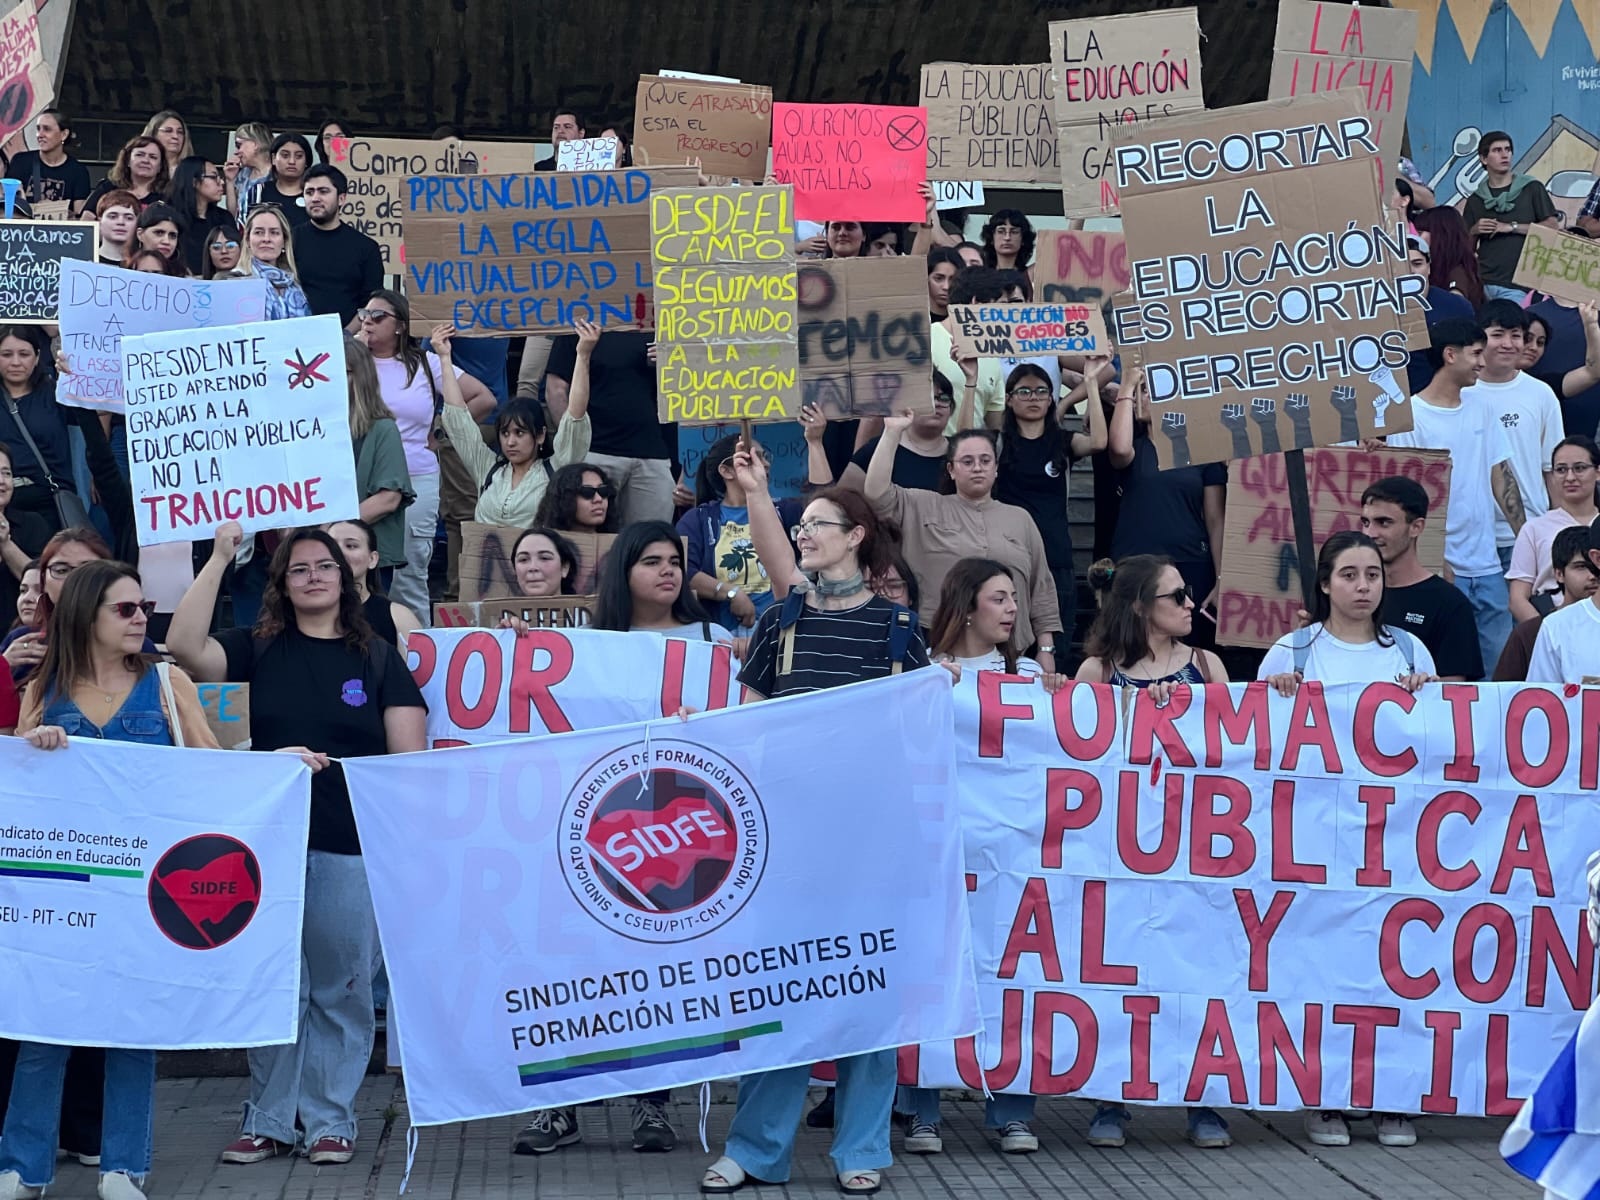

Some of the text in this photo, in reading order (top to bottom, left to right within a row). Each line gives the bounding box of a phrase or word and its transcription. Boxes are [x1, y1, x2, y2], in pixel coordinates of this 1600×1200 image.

[1063, 29, 1103, 62] LA
[1310, 3, 1364, 55] LA
[925, 69, 950, 98] LA
[1066, 49, 1189, 102] EDUCACIÓN
[1290, 58, 1394, 112] LUCHA
[689, 93, 770, 116] ATRASADO
[958, 101, 1053, 136] PÚBLICA
[643, 116, 707, 132] ESTA EL
[784, 108, 885, 141] QUEREMOS
[575, 151, 595, 165] EL
[776, 140, 862, 165] AULAS, NO
[926, 136, 951, 168] SE
[1114, 116, 1379, 188] RECORTAR
[406, 169, 651, 213] PRESENCIALIDAD
[774, 167, 872, 190] PANTALLAS
[651, 190, 794, 236] DESDE EL
[1204, 187, 1274, 236] LA
[0, 225, 84, 244] endamos
[5, 242, 36, 262] LA
[458, 217, 612, 256] LA REGLA
[654, 232, 786, 264] CAMPO
[410, 259, 653, 295] VIRTUALIDAD L
[1132, 221, 1408, 301] EDUCACIÓN
[70, 269, 190, 314] DERECHO
[655, 265, 798, 307] SEGUIMOS
[104, 313, 125, 333] A
[657, 305, 793, 342] APOSTANDO
[954, 305, 1090, 324] LA EDUCACIÓN NO
[1114, 274, 1432, 346] ES RECORTAR
[962, 321, 1090, 340] ES UN GASTO ES
[974, 339, 1016, 355] UNA
[126, 336, 267, 381] PRESIDENTE
[668, 344, 741, 367] A LA
[1145, 329, 1412, 403] DERECHOS
[126, 366, 268, 406] USTED APRENDIÓ
[659, 362, 795, 395] EDUCACIÓN
[129, 398, 249, 434] GRACIAS A LA
[665, 387, 788, 422] PÚBLICA
[131, 416, 326, 464] EDUCACIÓN PÚBLICA,
[151, 456, 222, 490] NO LA
[140, 476, 326, 531] TRAICIONE
[48, 827, 65, 842] de
[68, 829, 129, 848] Docentes
[131, 836, 149, 850] de
[570, 750, 758, 913] SINDICATO DE DOCENTES DE FORMACIÓN EN EDUCACIÓN
[605, 809, 728, 873] SIDFE
[1040, 756, 1556, 899] PÚBLICA
[56, 850, 72, 861] en
[76, 848, 141, 867] Educación
[190, 880, 237, 895] SIDFE
[32, 908, 55, 925] PIT
[67, 911, 97, 929] CNT
[623, 898, 728, 933] CSEU/PIT-CNT
[965, 873, 1596, 1012] AL Y CON
[505, 928, 897, 1014] SINDICATO DE DOCENTES DE
[511, 964, 888, 1050] FORMACIÓN EN EDUCACIÓN
[897, 988, 1529, 1118] UDIANTIL
